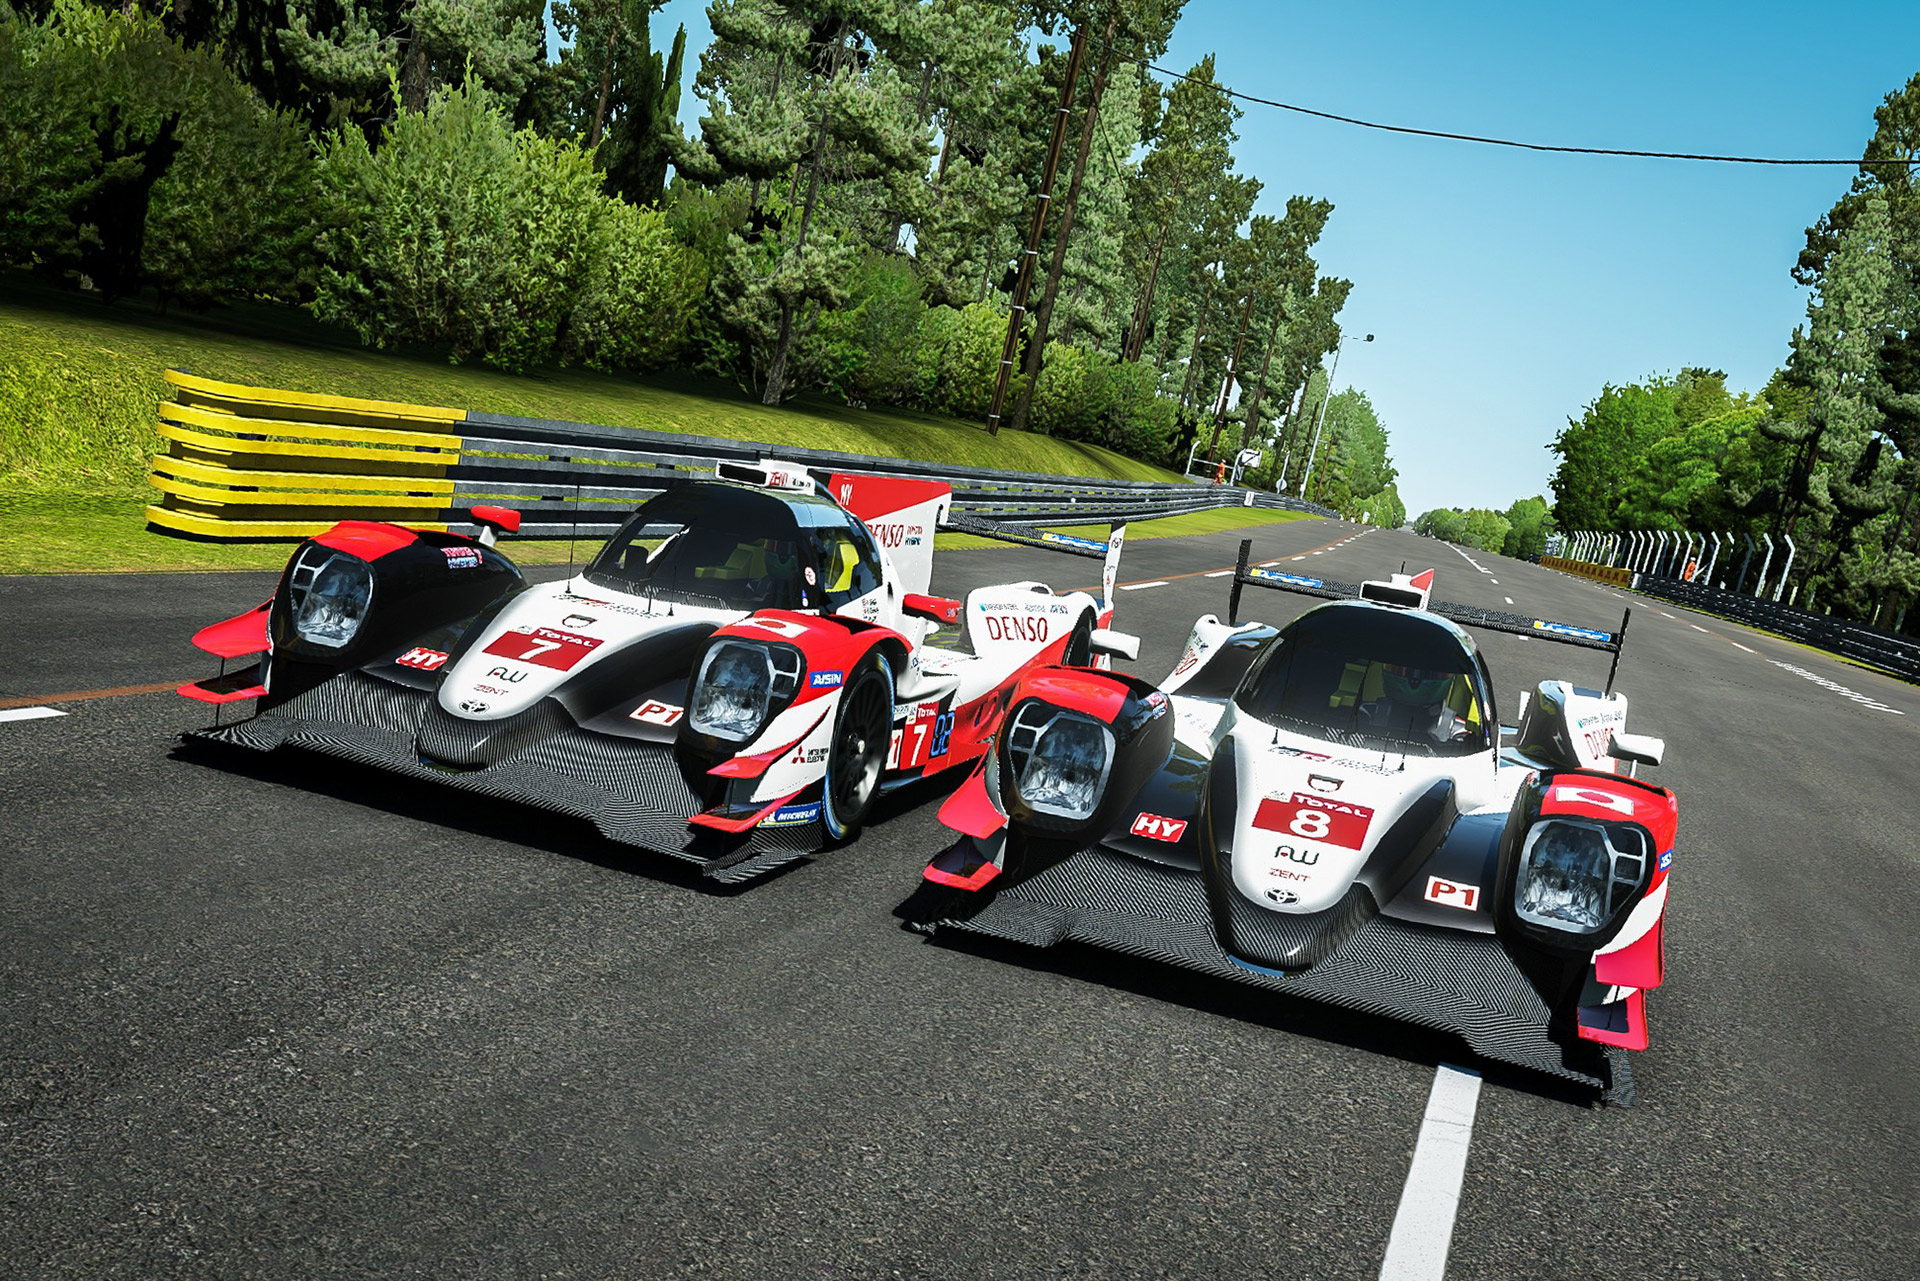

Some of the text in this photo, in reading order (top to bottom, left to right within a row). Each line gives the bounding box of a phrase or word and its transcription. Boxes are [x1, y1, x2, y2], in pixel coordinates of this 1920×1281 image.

[538, 629, 594, 648] TOTAL
[985, 615, 1048, 643] DENSO
[401, 650, 448, 667] HY
[518, 637, 563, 660] 7
[812, 672, 842, 686] AISIN
[637, 703, 684, 723] P1
[917, 707, 936, 719] TOTAL
[910, 724, 928, 767] 7
[777, 808, 818, 821] MICHELIN
[1294, 794, 1368, 818] TOTAL
[1135, 816, 1184, 838] HY
[1289, 808, 1332, 839] 8
[1269, 867, 1312, 883] ZENT
[1430, 881, 1475, 907] P1
